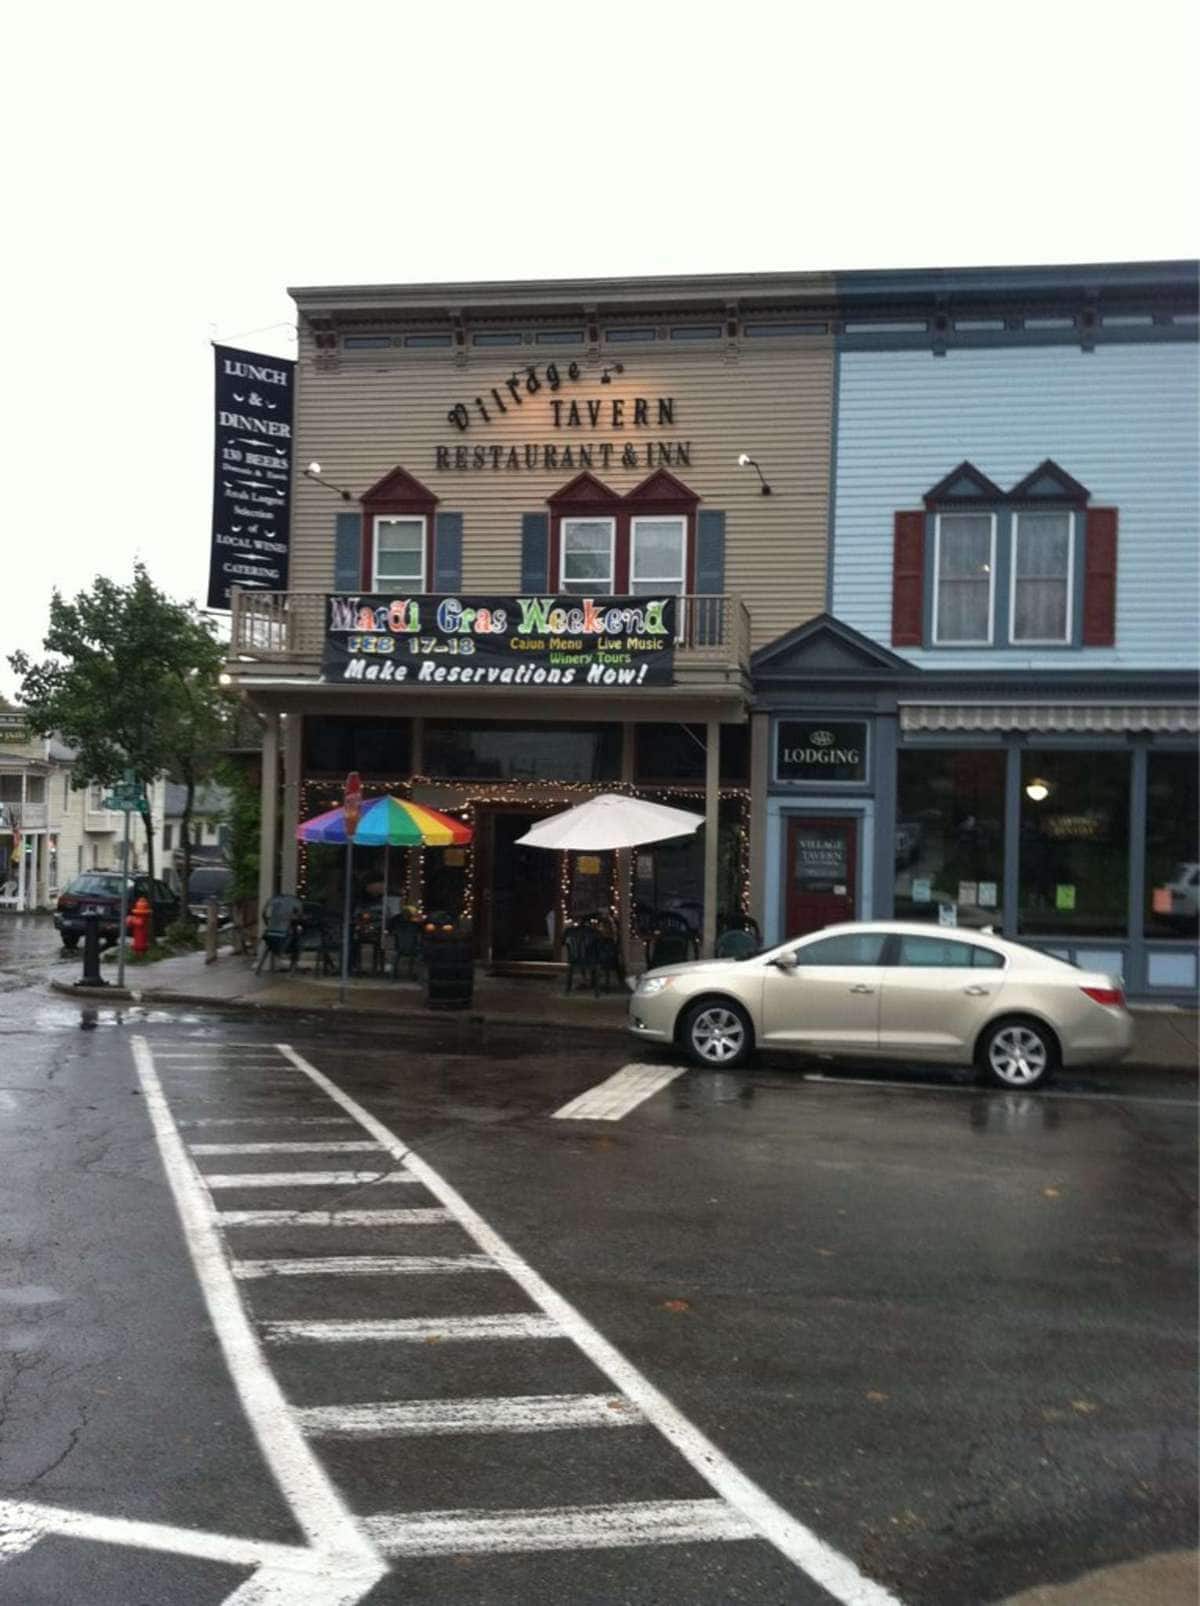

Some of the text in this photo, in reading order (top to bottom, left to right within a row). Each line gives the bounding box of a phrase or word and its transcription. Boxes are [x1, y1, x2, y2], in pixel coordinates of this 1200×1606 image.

[224, 360, 288, 386] LUNCH
[248, 392, 262, 406] &
[550, 398, 675, 427] TAVERN
[220, 411, 292, 438] DINNER
[246, 453, 288, 470] BEERS
[435, 441, 692, 470] RESTAURANT & INN
[223, 562, 280, 578] CATERING
[329, 597, 669, 635] Mardi Gras Weekend
[348, 636, 475, 655] FEB 17-18
[510, 637, 664, 650] Cajun Menu Live Music
[550, 652, 632, 665] Winery Tours
[344, 659, 648, 685] Make Reservations Now!
[784, 748, 860, 764] LODGING
